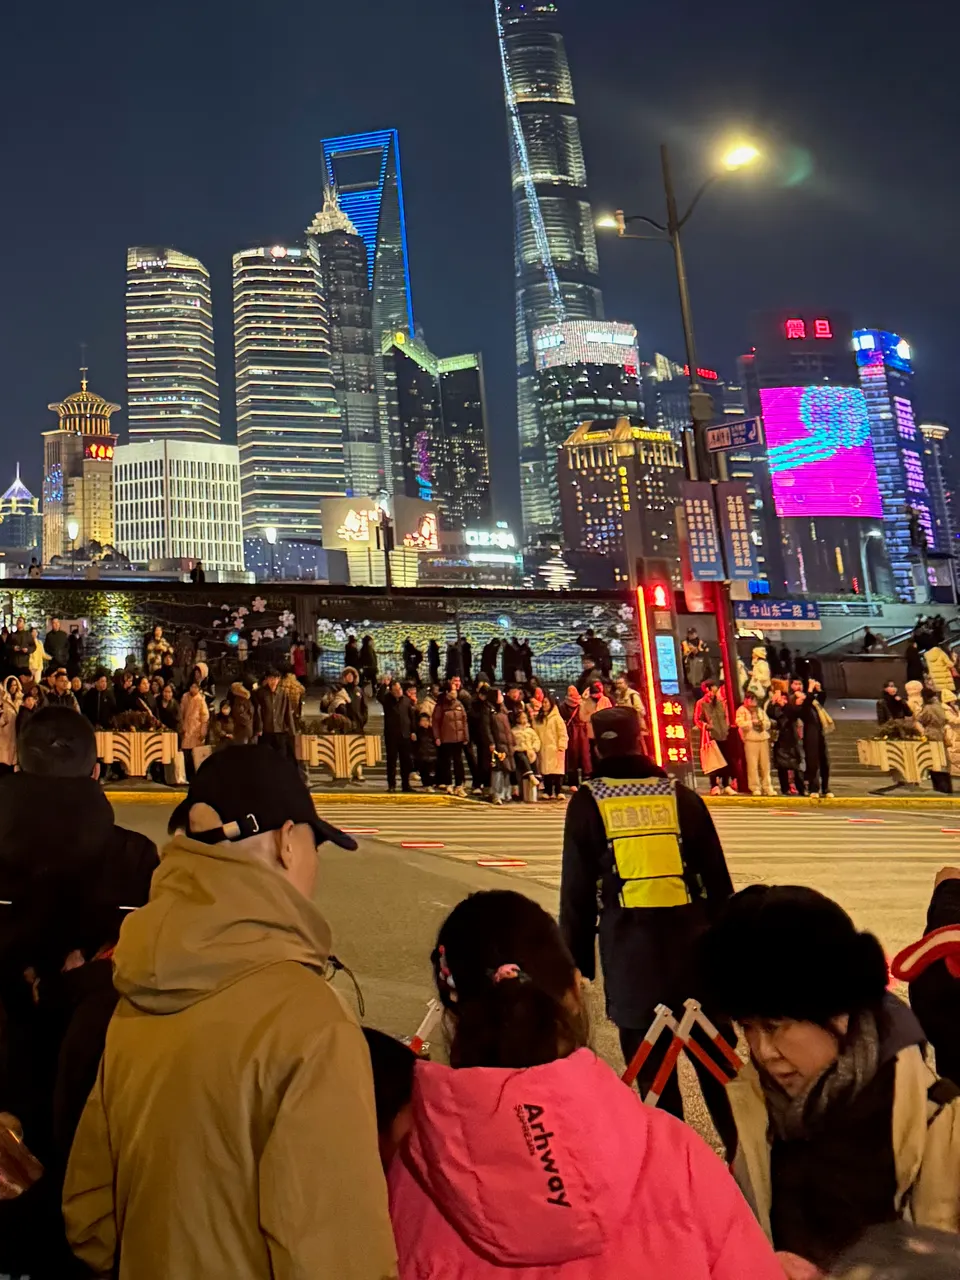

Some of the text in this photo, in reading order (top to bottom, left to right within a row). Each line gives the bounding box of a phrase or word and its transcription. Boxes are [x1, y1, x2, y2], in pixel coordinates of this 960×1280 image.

[786, 318, 833, 339] 震旦
[749, 603, 803, 618] 中山东一路
[523, 1103, 573, 1208] Arhway
